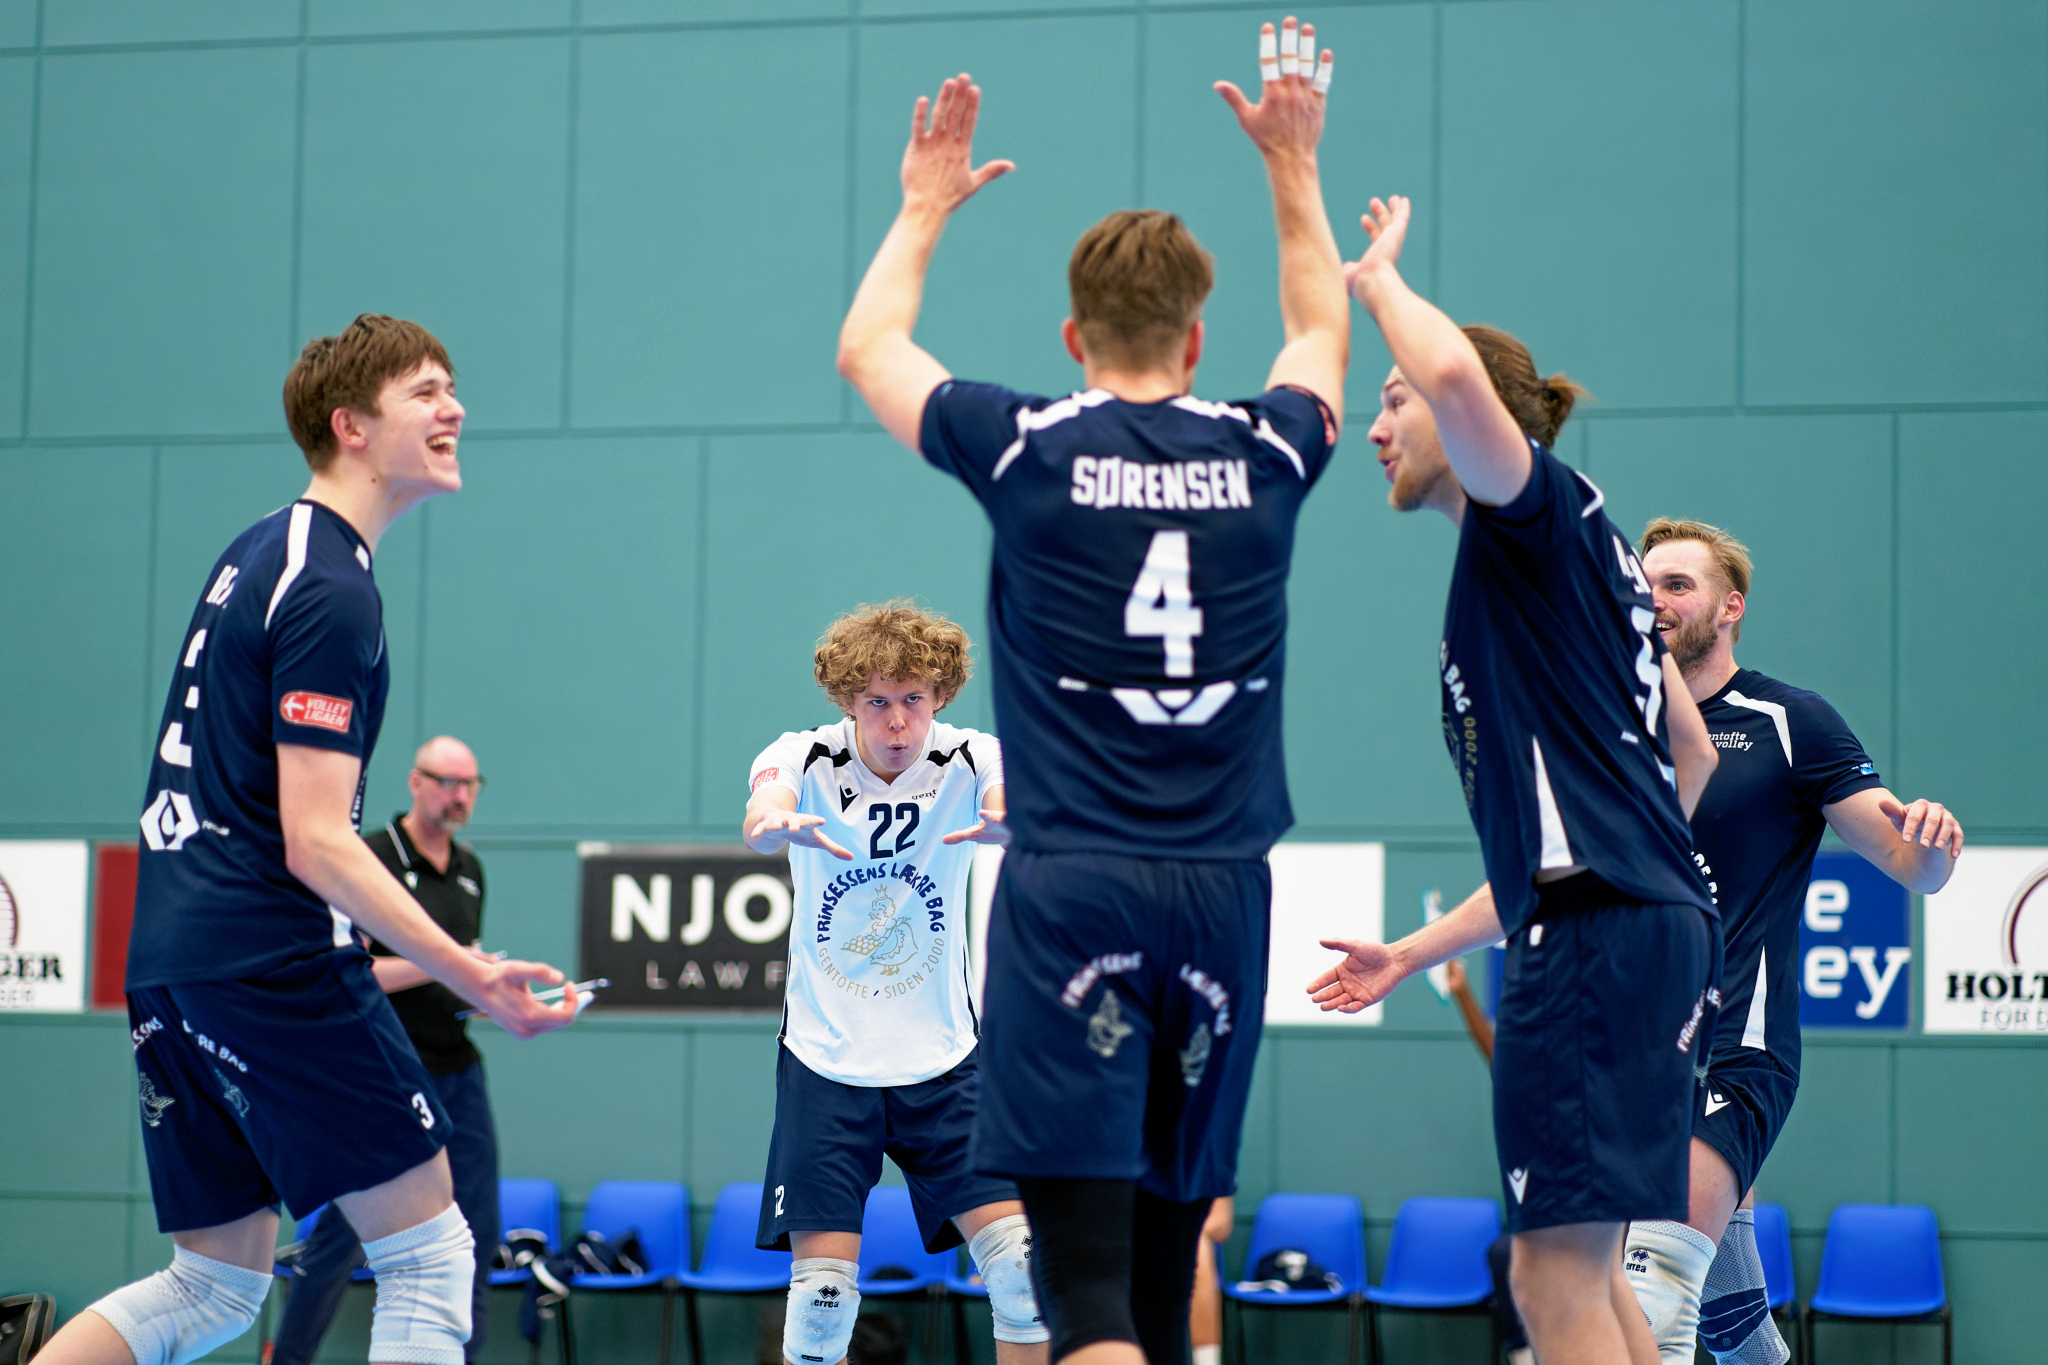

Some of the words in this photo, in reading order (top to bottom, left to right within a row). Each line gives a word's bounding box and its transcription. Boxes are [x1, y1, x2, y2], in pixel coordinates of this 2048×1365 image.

[1070, 455, 1252, 509] SØRENSEN
[1124, 529, 1204, 678] 4
[303, 709, 347, 727] LIGAEN
[306, 698, 349, 714] VOLLEY
[1715, 741, 1754, 752] volley
[868, 802, 920, 860] 22
[890, 862, 937, 898] LÆKRE
[925, 896, 946, 933] BAG
[646, 960, 750, 990] LAW
[818, 947, 869, 999] GENTOFTE
[884, 970, 925, 999] SIDEN
[922, 937, 945, 974] 2000
[217, 1045, 248, 1073] BAG
[411, 1091, 435, 1130] 3
[1626, 1262, 1647, 1274] errea
